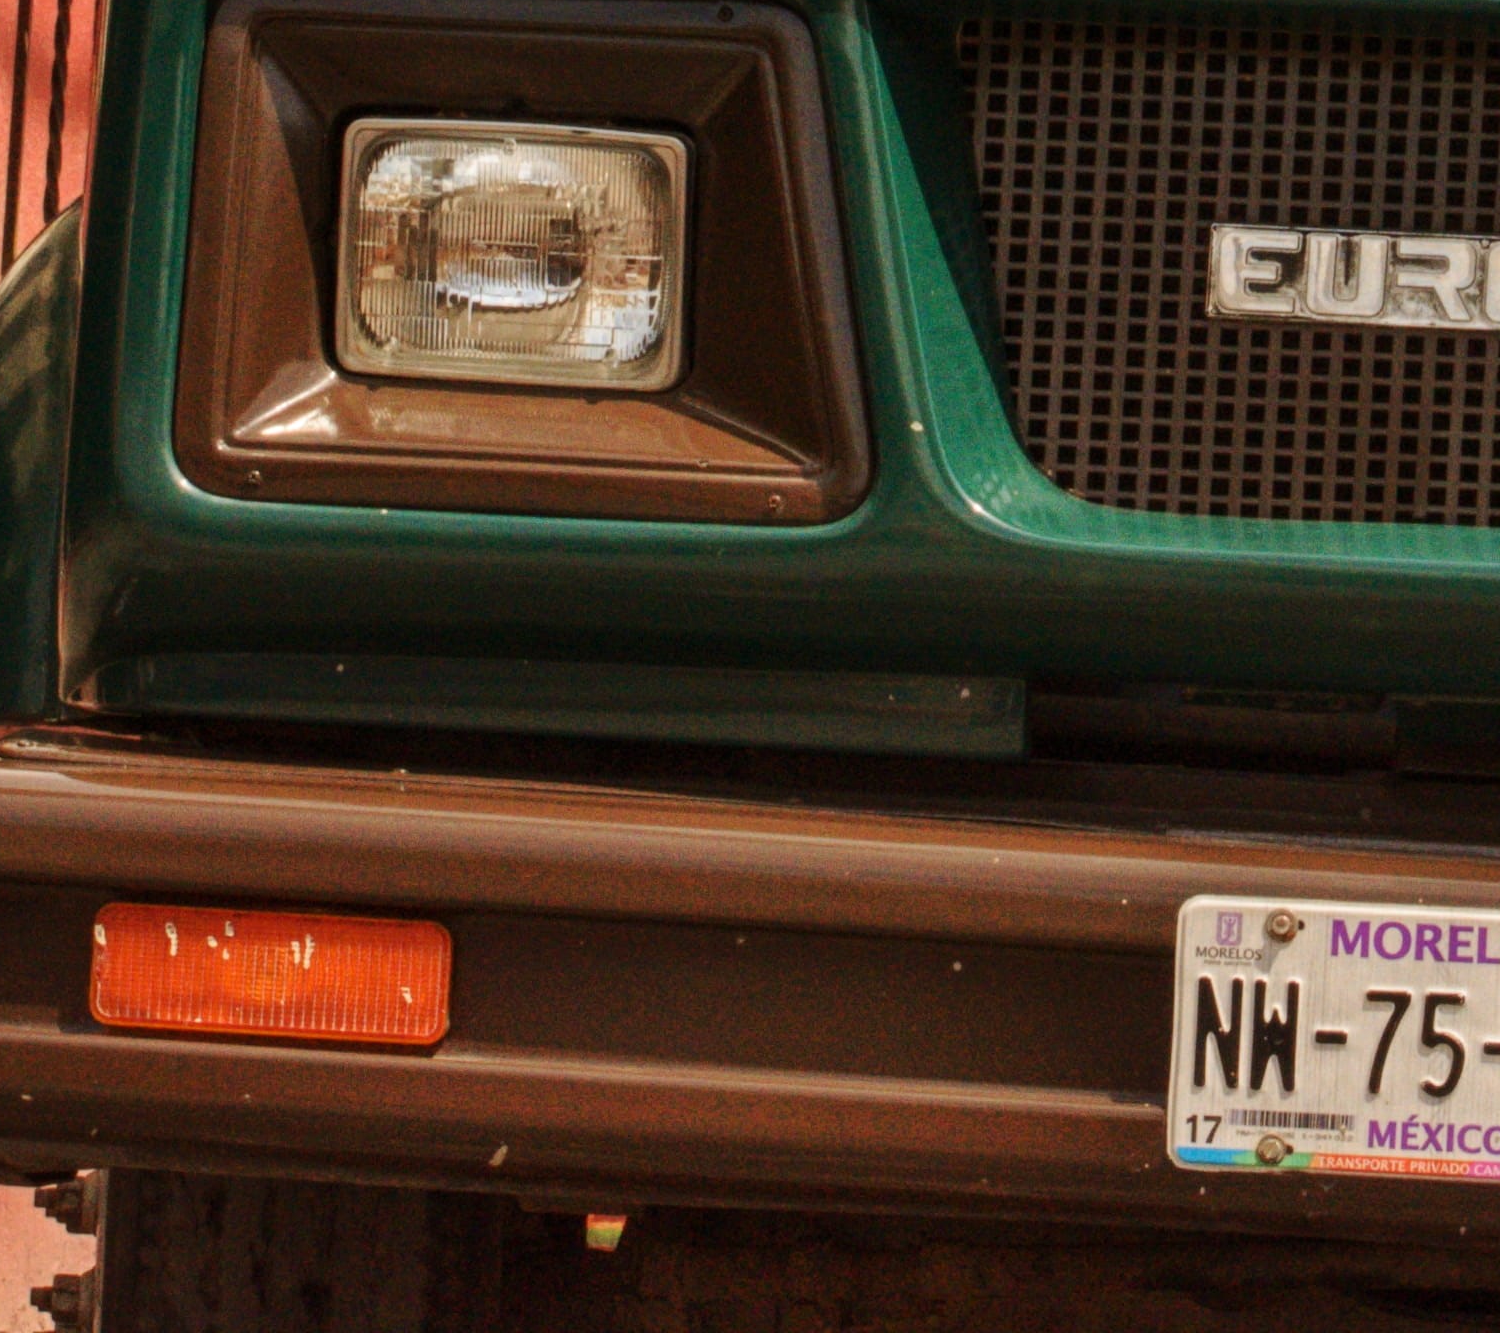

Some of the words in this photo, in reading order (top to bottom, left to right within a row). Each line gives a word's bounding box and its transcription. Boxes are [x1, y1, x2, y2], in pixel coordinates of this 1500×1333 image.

[1195, 945, 1263, 961] MORELOS
[1184, 1113, 1223, 1144] 17
[1317, 1156, 1406, 1172] TRANSPORTE
[1410, 1160, 1469, 1175] PRIVADO
